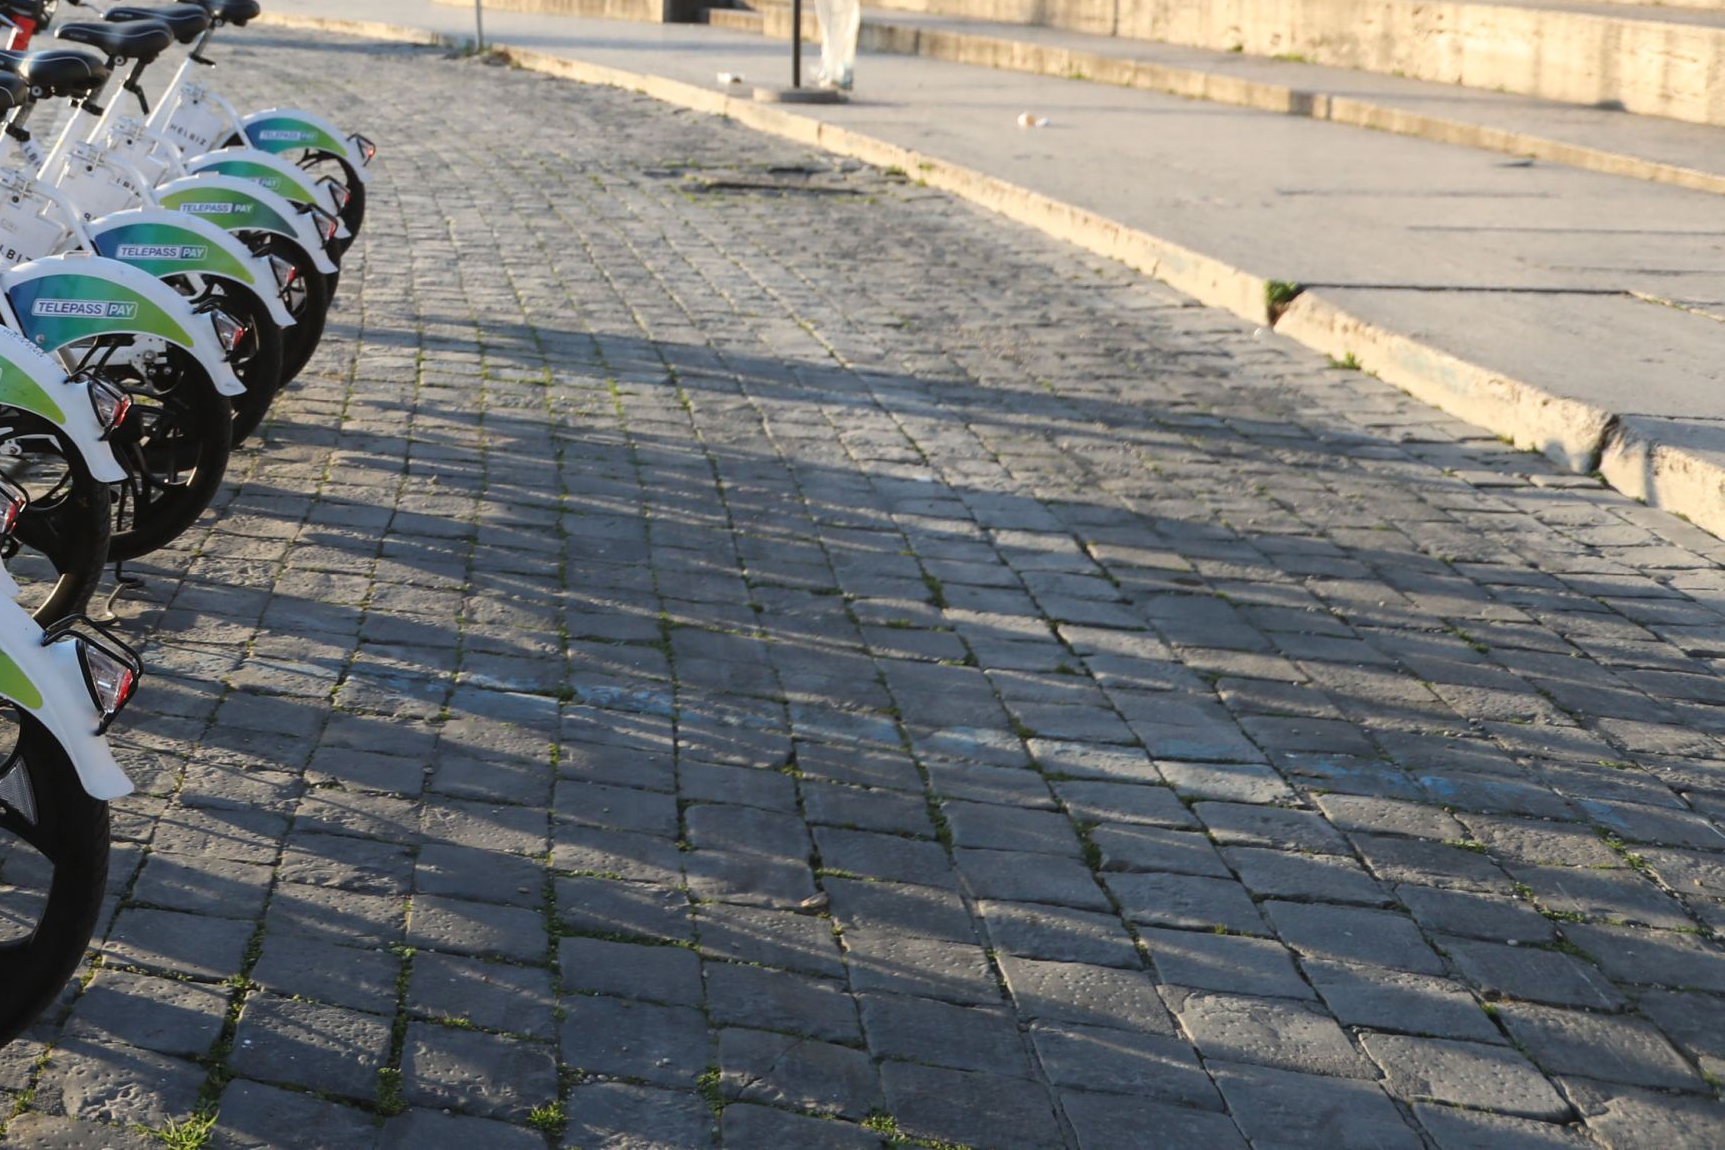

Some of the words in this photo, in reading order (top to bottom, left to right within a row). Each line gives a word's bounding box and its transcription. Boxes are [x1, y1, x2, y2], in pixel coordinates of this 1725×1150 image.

[235, 204, 253, 212] PAY
[121, 247, 176, 257] TELEPASS
[182, 248, 204, 257] PAY
[39, 302, 102, 315] TELEPASS
[109, 305, 134, 316] PAY
